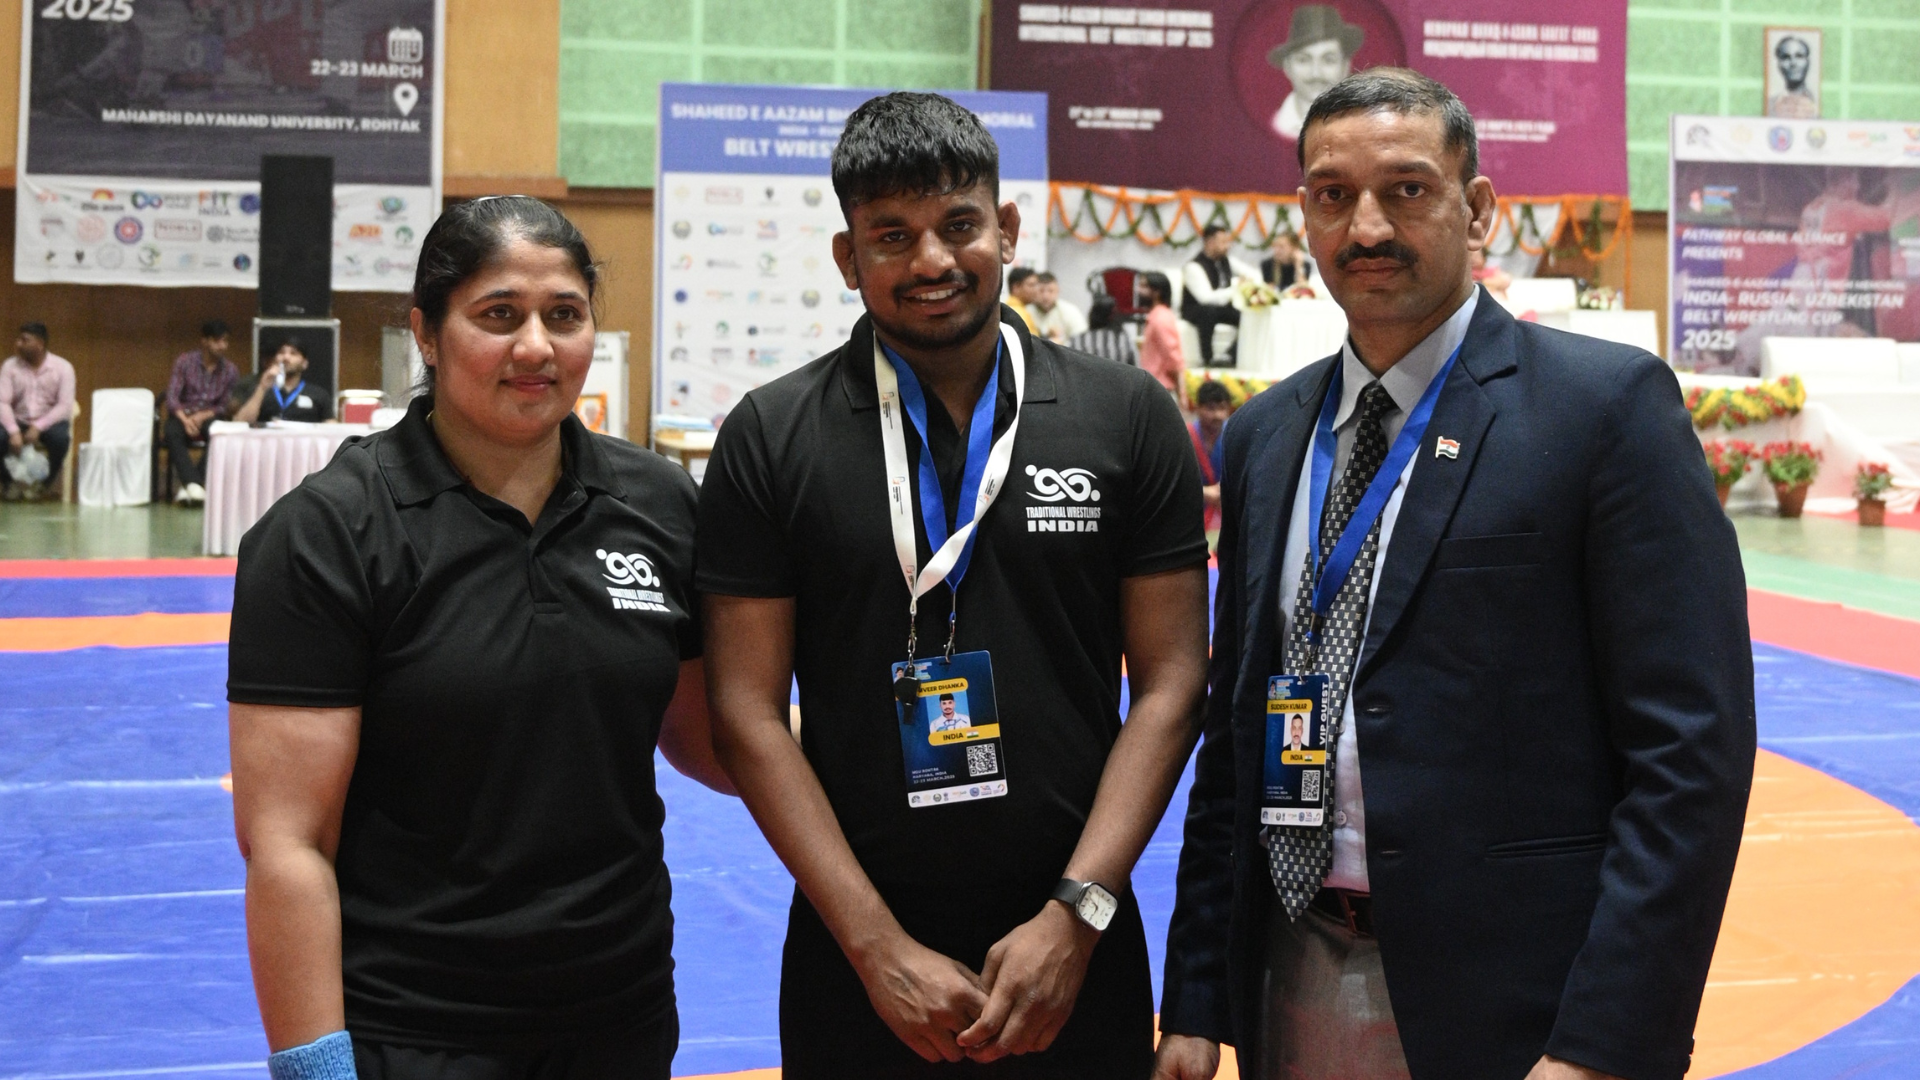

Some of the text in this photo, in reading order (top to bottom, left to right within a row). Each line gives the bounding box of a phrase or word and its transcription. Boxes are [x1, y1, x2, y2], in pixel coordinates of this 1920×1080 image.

[41, 0, 134, 22] 2025
[310, 59, 424, 79] 22-23 MARCH
[101, 108, 421, 133] MAHARSHI DAYANAND UNIVERSITY, ROHTAK
[671, 102, 749, 121] SHAHEED
[750, 105, 760, 121] E
[763, 105, 825, 122] AAZAM
[826, 106, 854, 123] BH
[724, 137, 771, 157] BELT
[1682, 228, 1847, 246] PATHWAY GLOBAL ALLIANCE
[1681, 246, 1743, 261] PRESENTS
[1805, 293, 1904, 309] UZBEKISTAN
[1682, 309, 1844, 326] BELT WRESTLING CUP
[1681, 328, 1737, 351] 2025
[1025, 506, 1101, 518] TRADITIONAL WRESTLINGS
[1027, 520, 1099, 532] INDIA
[612, 597, 671, 612] INDIA
[938, 682, 964, 691] DHANKA
[1319, 682, 1329, 745] VIP GUEST
[943, 732, 963, 741] INDIA
